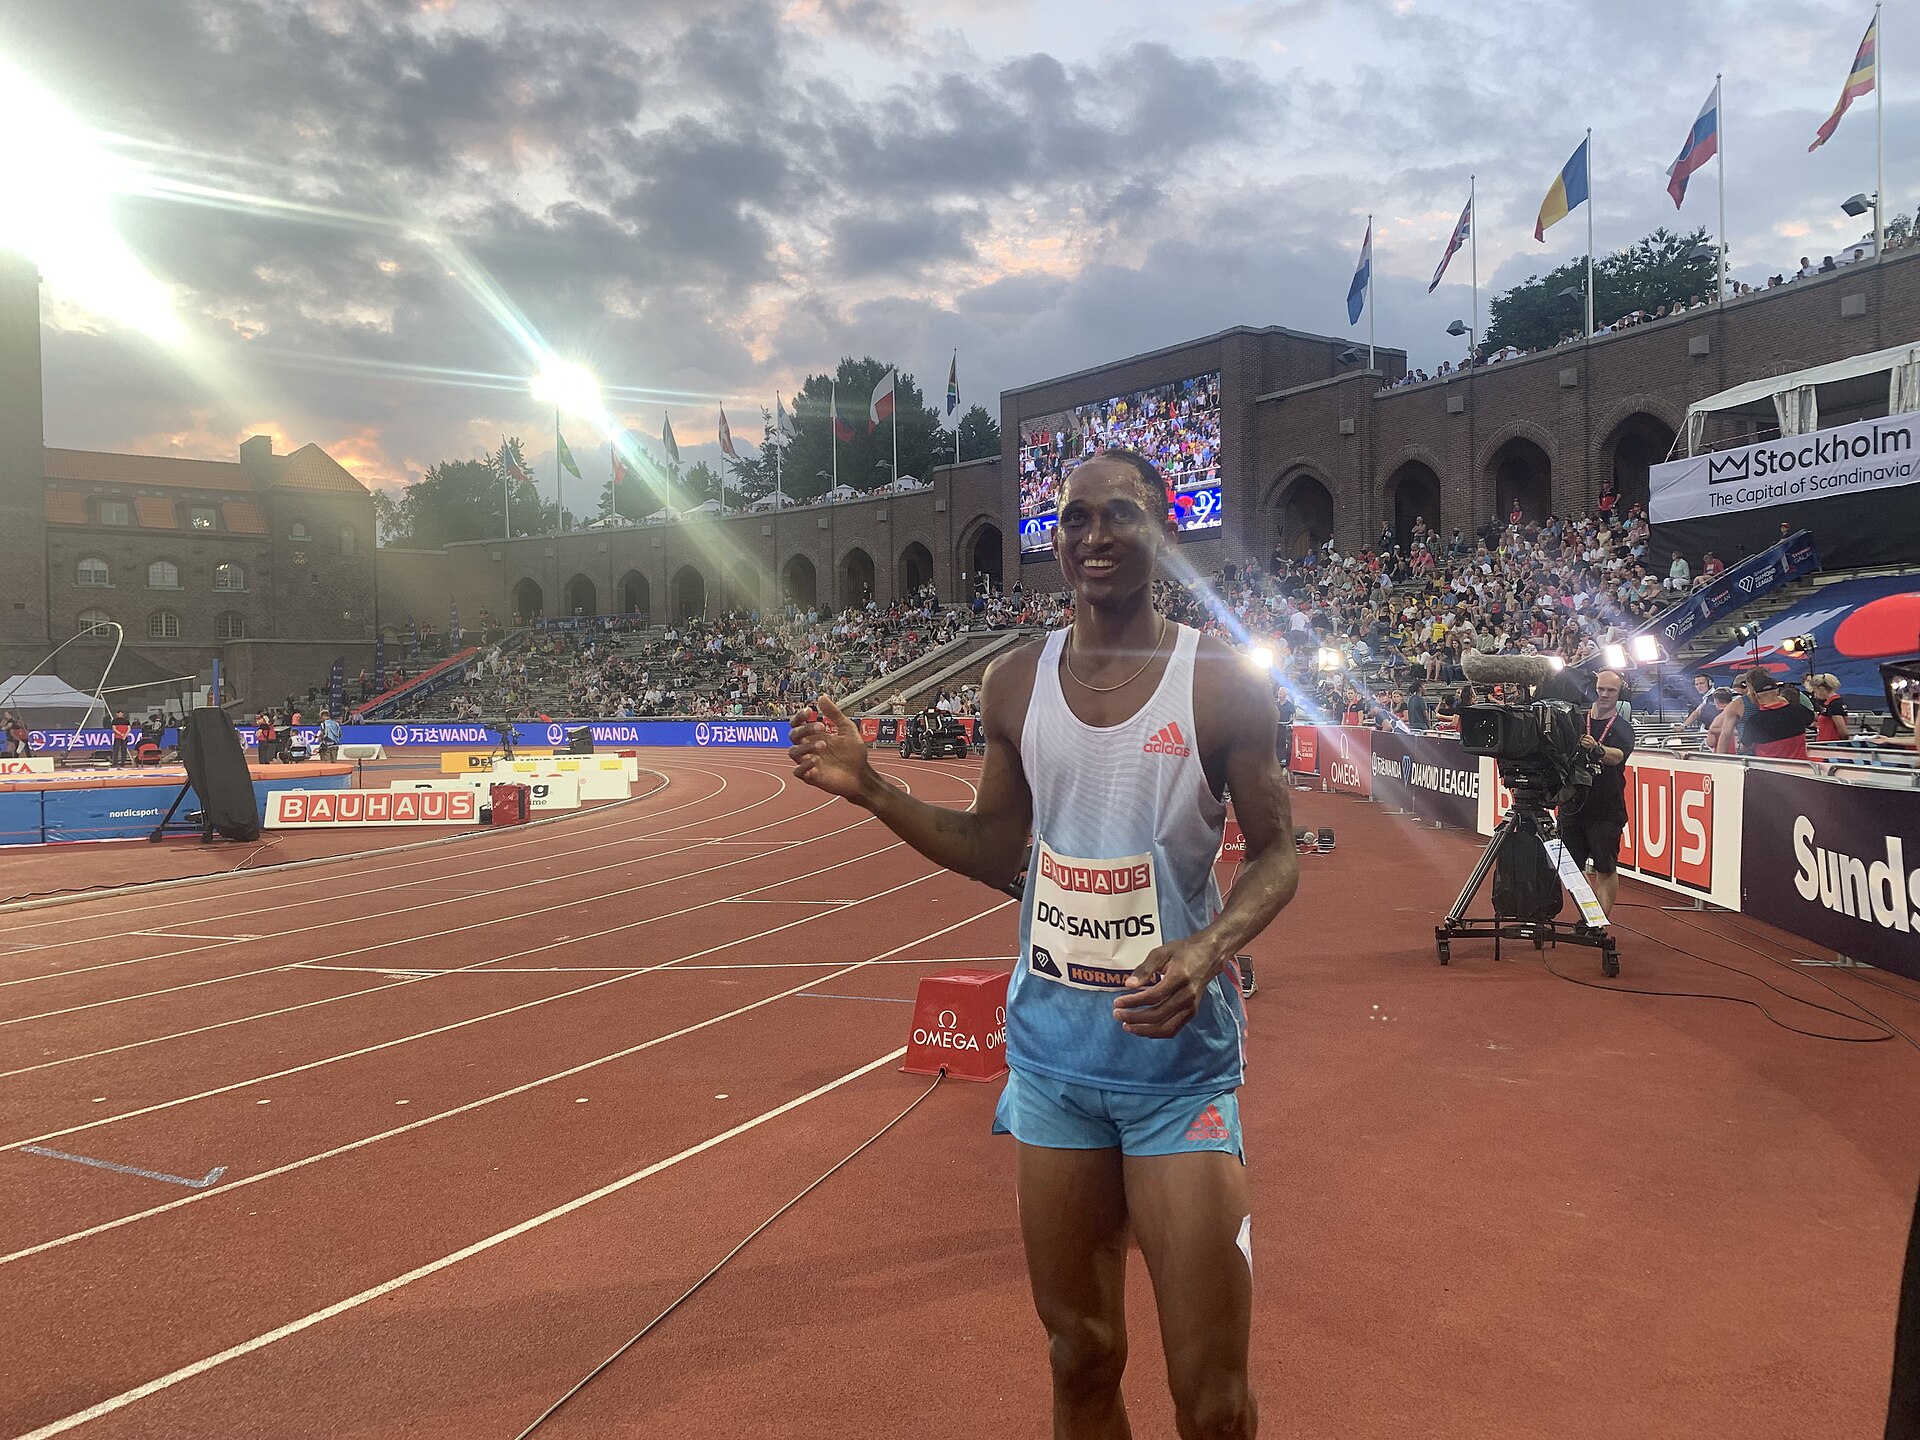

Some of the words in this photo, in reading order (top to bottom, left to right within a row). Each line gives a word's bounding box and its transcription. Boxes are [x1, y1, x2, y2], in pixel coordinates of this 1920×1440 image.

[1753, 425, 1912, 478] Stockholm
[1709, 491, 1733, 508] The
[1736, 480, 1787, 504] Capital
[1790, 477, 1806, 494] of
[1810, 461, 1912, 491] Scandinavia
[1143, 741, 1191, 758] adidas
[1, 762, 33, 773] ICA
[1331, 761, 1361, 788] OMEGA
[1411, 762, 1439, 791] DIAMOND
[1440, 767, 1480, 799] LEAGUE
[109, 807, 177, 818] nordicsport.co
[282, 795, 471, 819] BAUHAUS
[1224, 843, 1247, 851] OME
[1043, 853, 1149, 892] BAUHAUS
[1037, 901, 1066, 932] DOS
[1067, 913, 1156, 940] SANTOS
[913, 1028, 980, 1052] OMEGA
[986, 1027, 1006, 1050] OME
